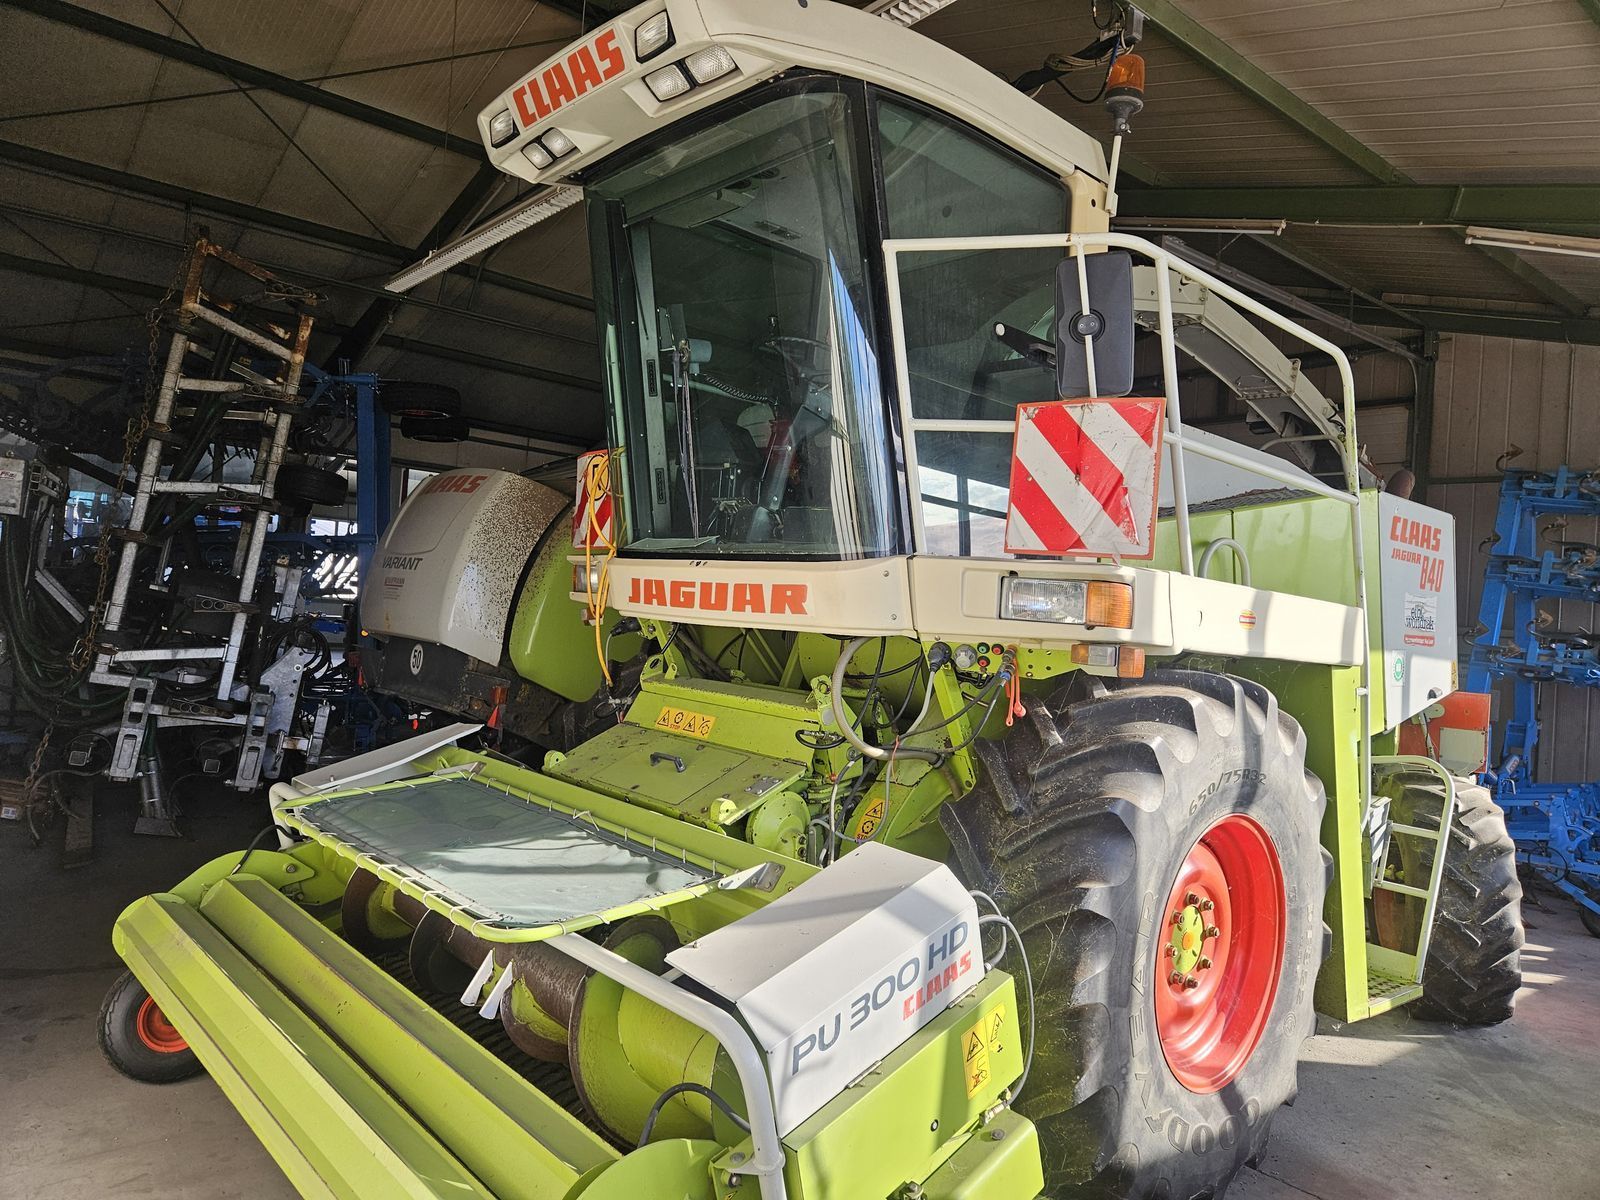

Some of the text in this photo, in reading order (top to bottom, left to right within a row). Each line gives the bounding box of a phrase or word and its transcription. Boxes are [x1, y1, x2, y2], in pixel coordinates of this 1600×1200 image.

[512, 28, 626, 129] CLAAS
[1390, 515, 1442, 552] CLAAS
[382, 556, 423, 571] VARIANT
[1391, 547, 1445, 592] JAGUAR 840
[628, 578, 808, 615] JAGUAR
[411, 649, 422, 669] 50
[1188, 768, 1267, 817] 650/75R32
[792, 921, 968, 1076] PU 300 HD
[902, 950, 972, 1021] CLAAS
